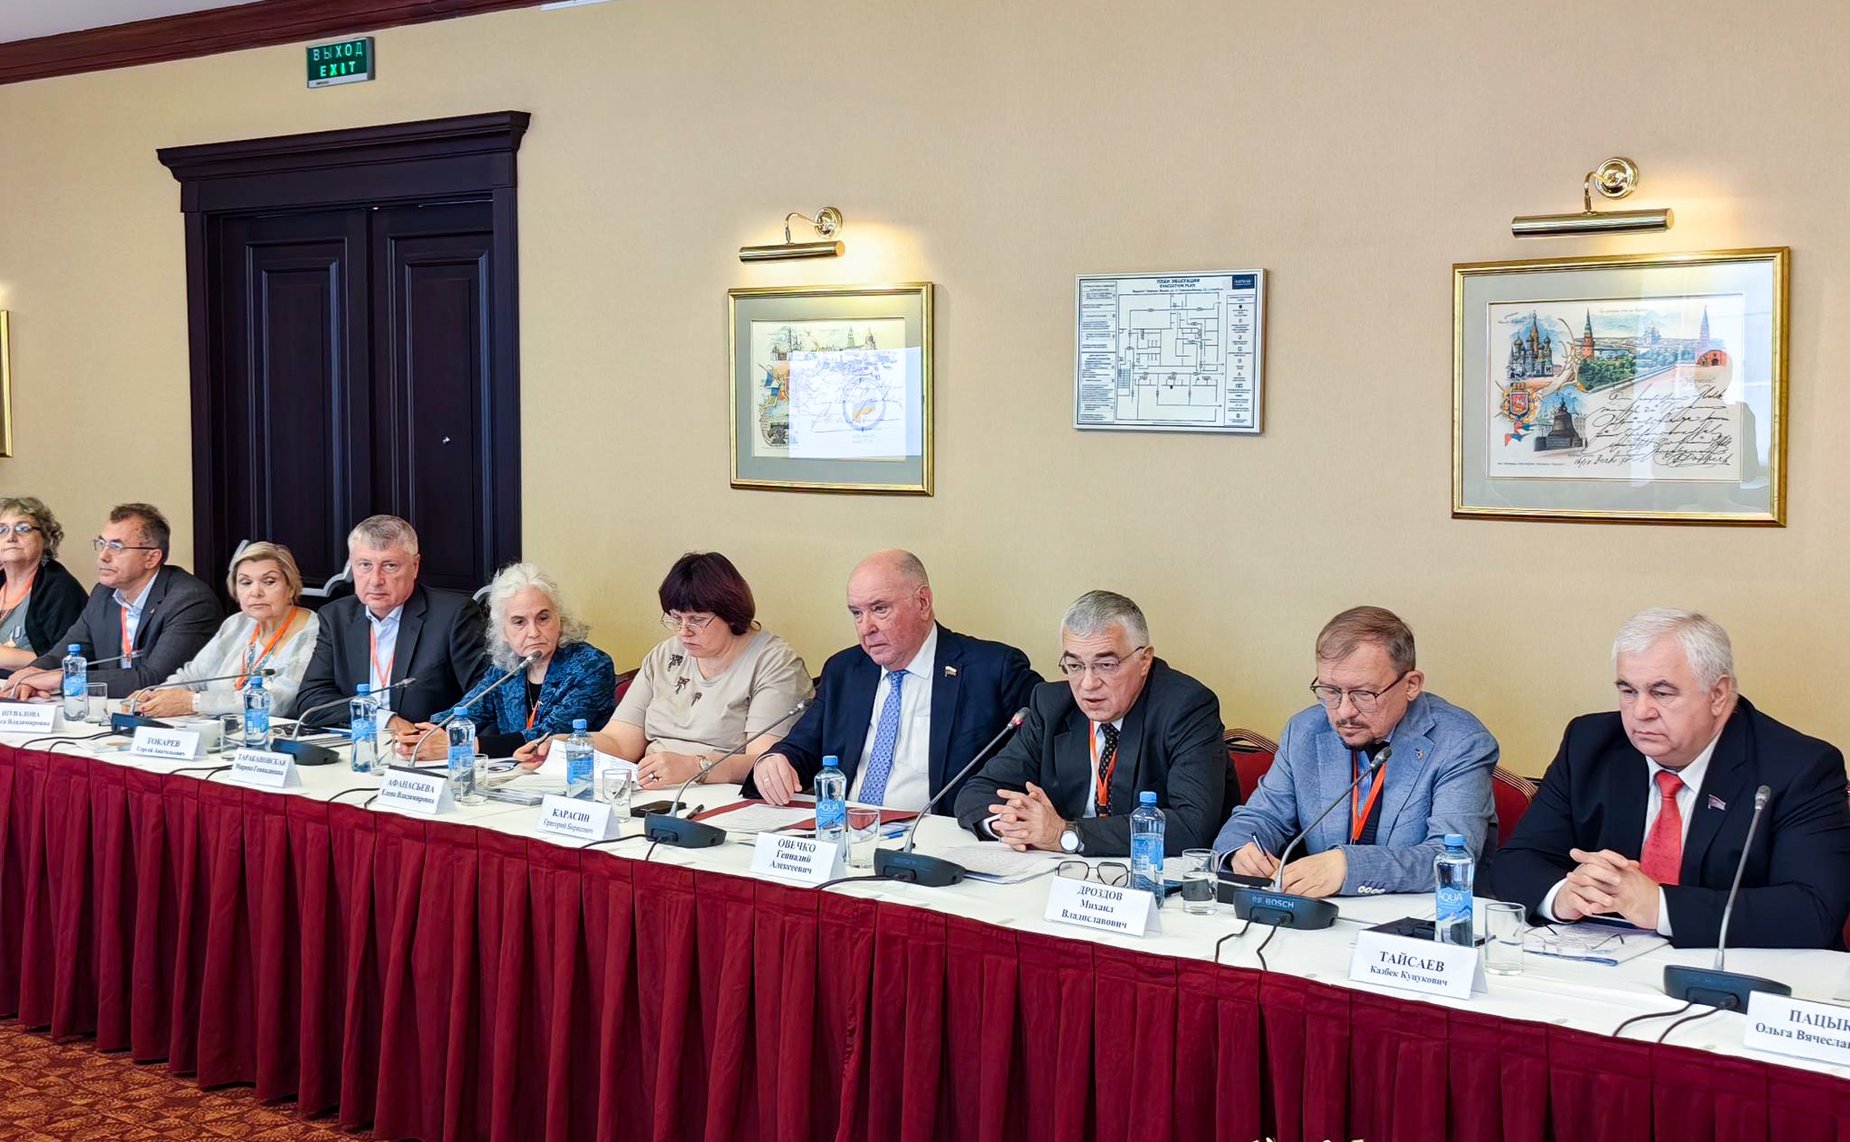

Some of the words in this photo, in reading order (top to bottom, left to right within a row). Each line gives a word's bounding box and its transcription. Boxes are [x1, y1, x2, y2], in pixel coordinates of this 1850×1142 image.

[313, 42, 363, 61] ВЫХОД
[320, 61, 356, 77] EXIT
[147, 737, 181, 747] ТОКАРЕВ
[388, 780, 435, 793] АФАНАСЬЕВА
[818, 803, 840, 811] AQUA
[552, 808, 590, 823] КАРАСИН
[777, 838, 816, 853] ОВЕЧКО
[776, 849, 811, 863] Геннадий
[769, 860, 812, 875] Алексеевич
[1077, 885, 1123, 901] ДРОЗДОВ
[1080, 898, 1114, 913] Михаил
[1265, 897, 1294, 909] BOSCH
[1061, 908, 1127, 929] Владиславович
[1379, 950, 1445, 972] ТАЙСАЕВ
[1370, 965, 1399, 979] Казбек
[1400, 970, 1448, 987] Куцукович
[1755, 1022, 1793, 1039] Ольга
